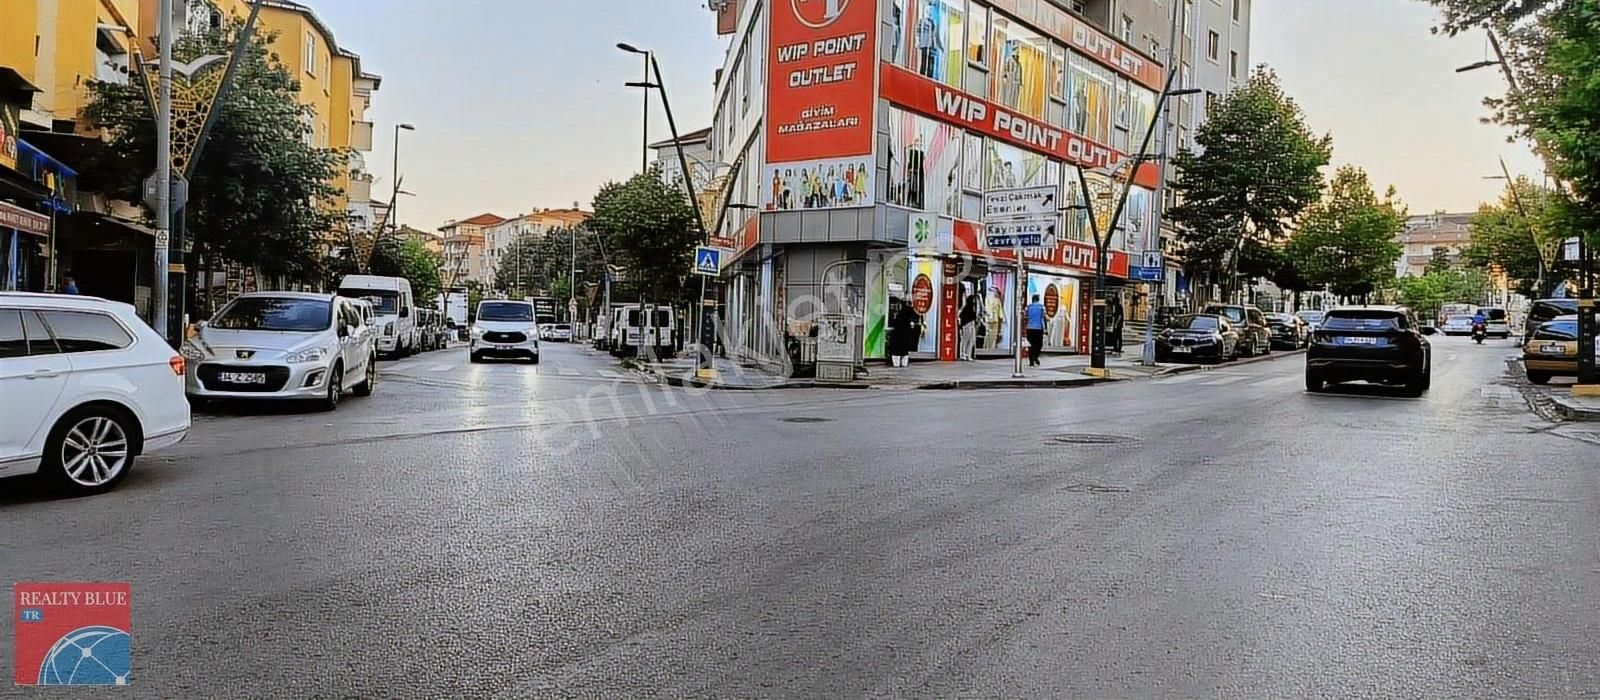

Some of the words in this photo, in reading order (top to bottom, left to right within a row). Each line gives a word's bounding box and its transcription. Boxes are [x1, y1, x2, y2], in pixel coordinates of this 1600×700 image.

[777, 43, 808, 62] WIP
[813, 34, 866, 57] POINT
[789, 63, 857, 87] OUTLET
[935, 87, 986, 122] WIP
[993, 109, 1062, 150] POINT
[988, 225, 1041, 235] Kaynarca
[1062, 245, 1114, 271] OUTLT
